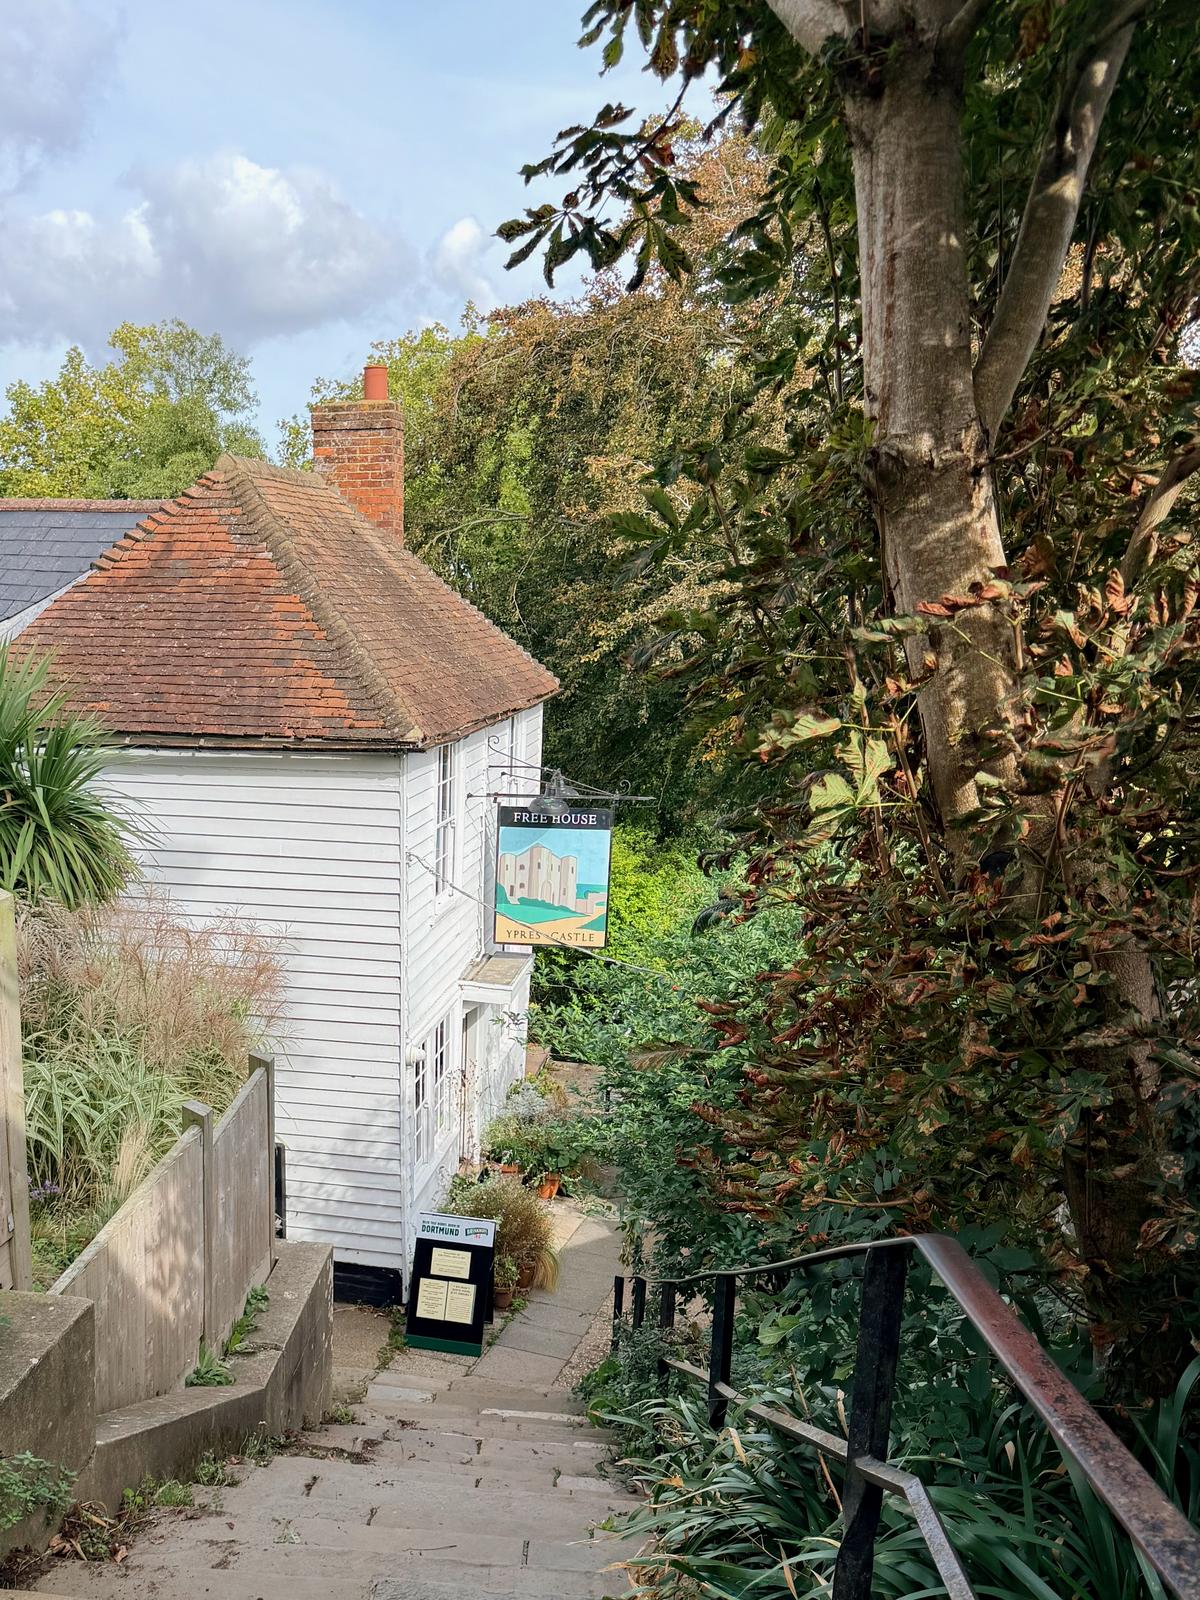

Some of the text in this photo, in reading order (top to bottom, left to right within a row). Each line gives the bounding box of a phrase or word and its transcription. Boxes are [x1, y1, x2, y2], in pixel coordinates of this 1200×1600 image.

[513, 812, 597, 825] FREE HOUSE
[506, 929, 595, 942] YPRES CASTLE
[421, 1224, 460, 1237] DORTMUND
